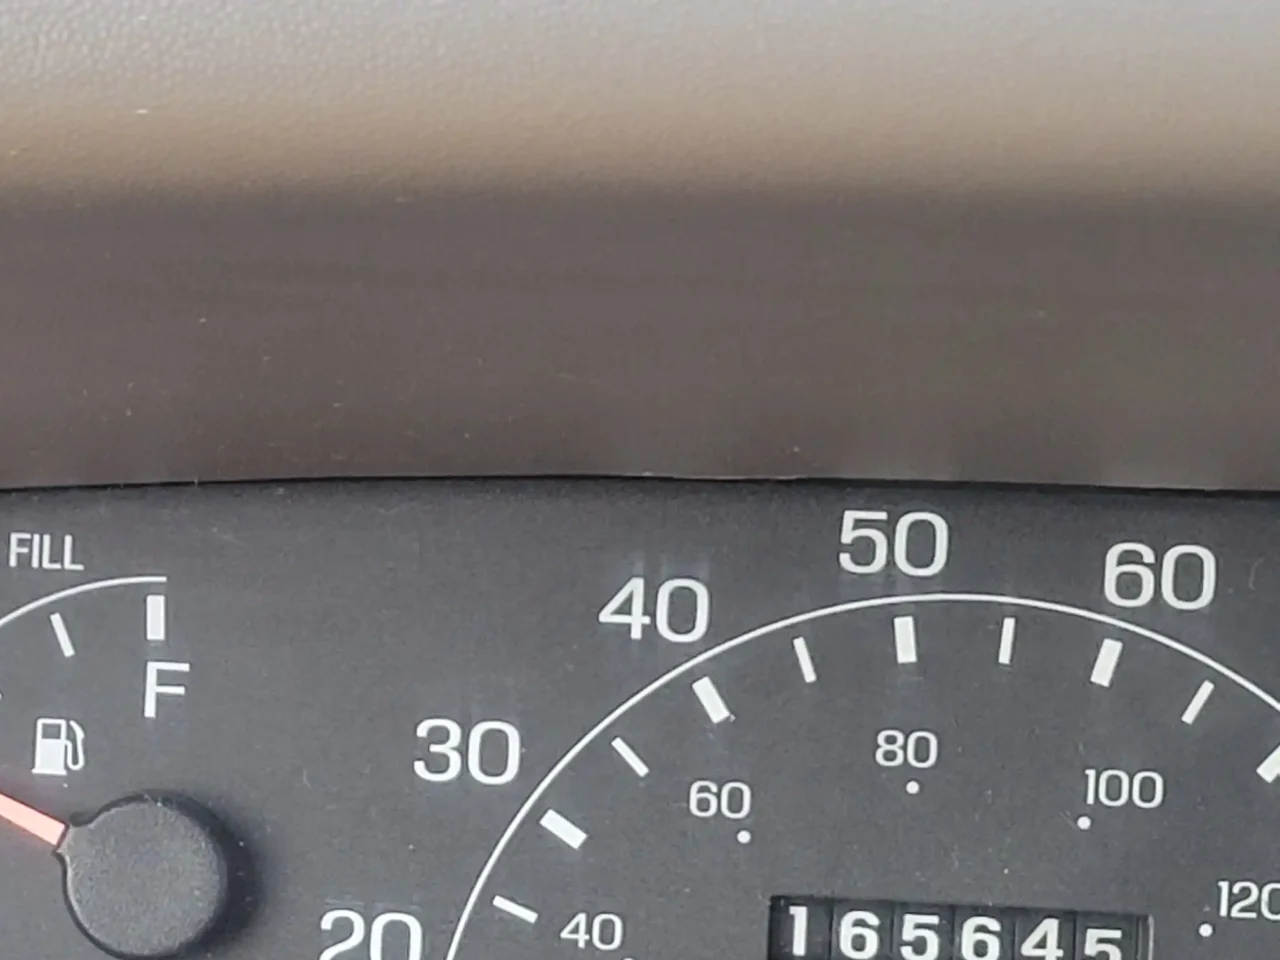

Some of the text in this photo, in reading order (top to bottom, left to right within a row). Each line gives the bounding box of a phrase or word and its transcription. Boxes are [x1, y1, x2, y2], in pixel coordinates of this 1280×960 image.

[9, 532, 85, 571] FILL
[839, 510, 948, 577] 50
[1104, 542, 1217, 610] 60
[598, 577, 709, 643] 40
[144, 661, 190, 718] F
[413, 718, 520, 785] 30
[875, 730, 938, 768] 80
[689, 780, 751, 819] 60
[1085, 769, 1163, 809] 100
[560, 913, 622, 950] 40
